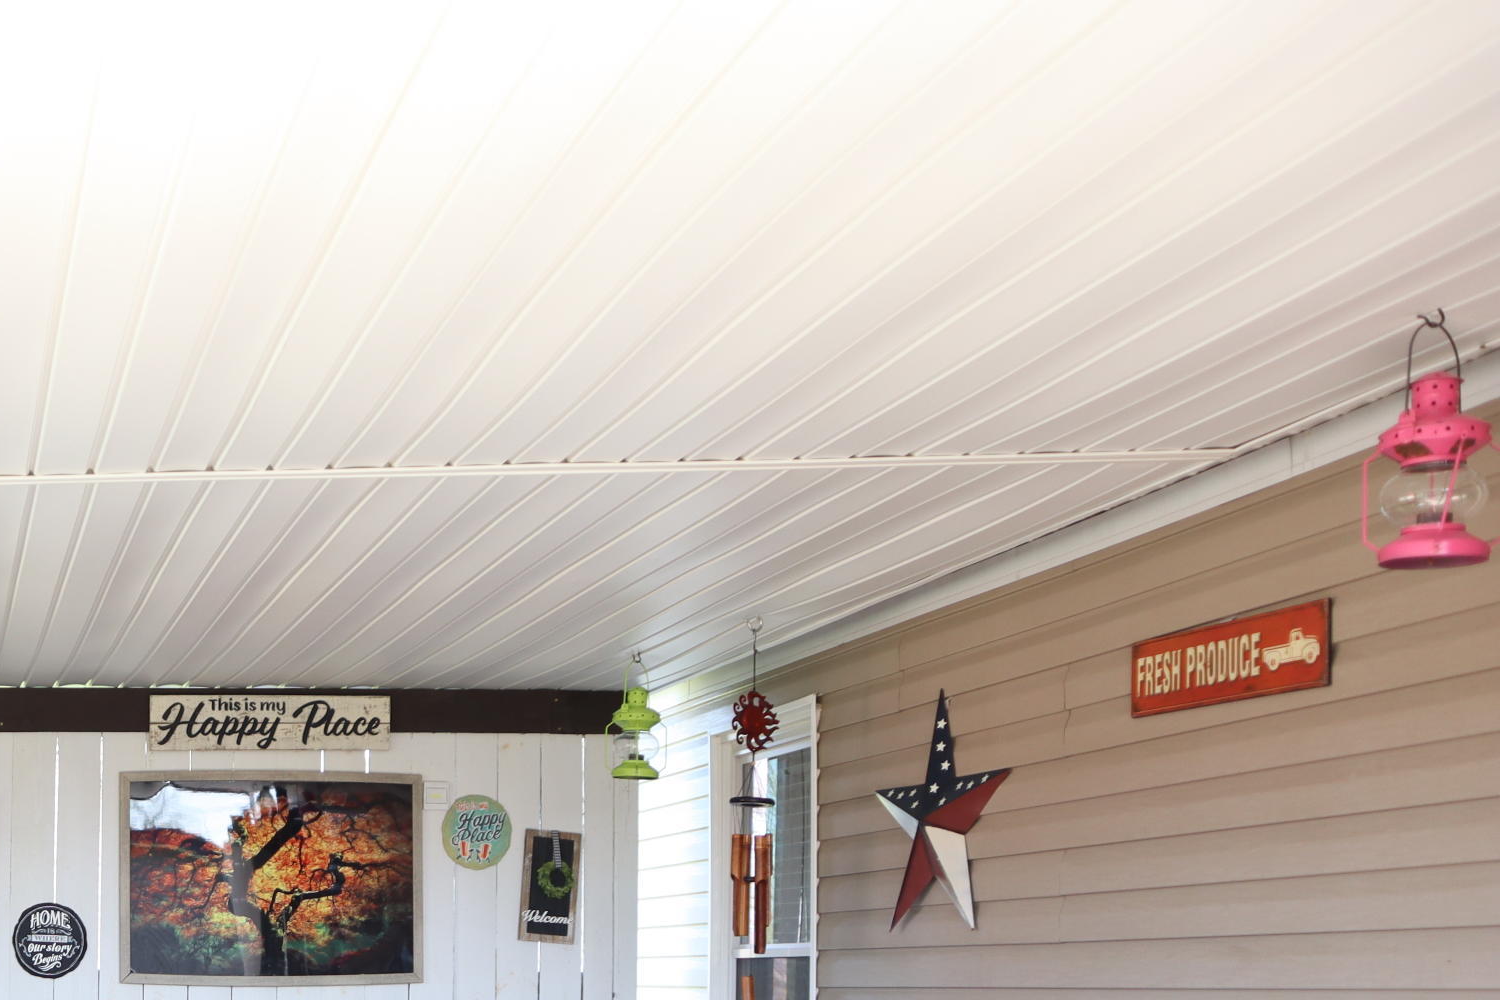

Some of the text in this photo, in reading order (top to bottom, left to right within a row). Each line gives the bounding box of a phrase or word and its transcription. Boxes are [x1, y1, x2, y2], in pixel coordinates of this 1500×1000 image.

[1136, 632, 1261, 697] FRESH PRODUCE
[208, 697, 286, 715] This is my
[157, 700, 381, 749] Happy Place
[457, 810, 507, 832] Happy
[452, 828, 501, 845] Place
[30, 909, 72, 930] HOME
[521, 909, 574, 925] Welcome
[27, 942, 72, 956] Our story
[32, 952, 62, 968] Begins
